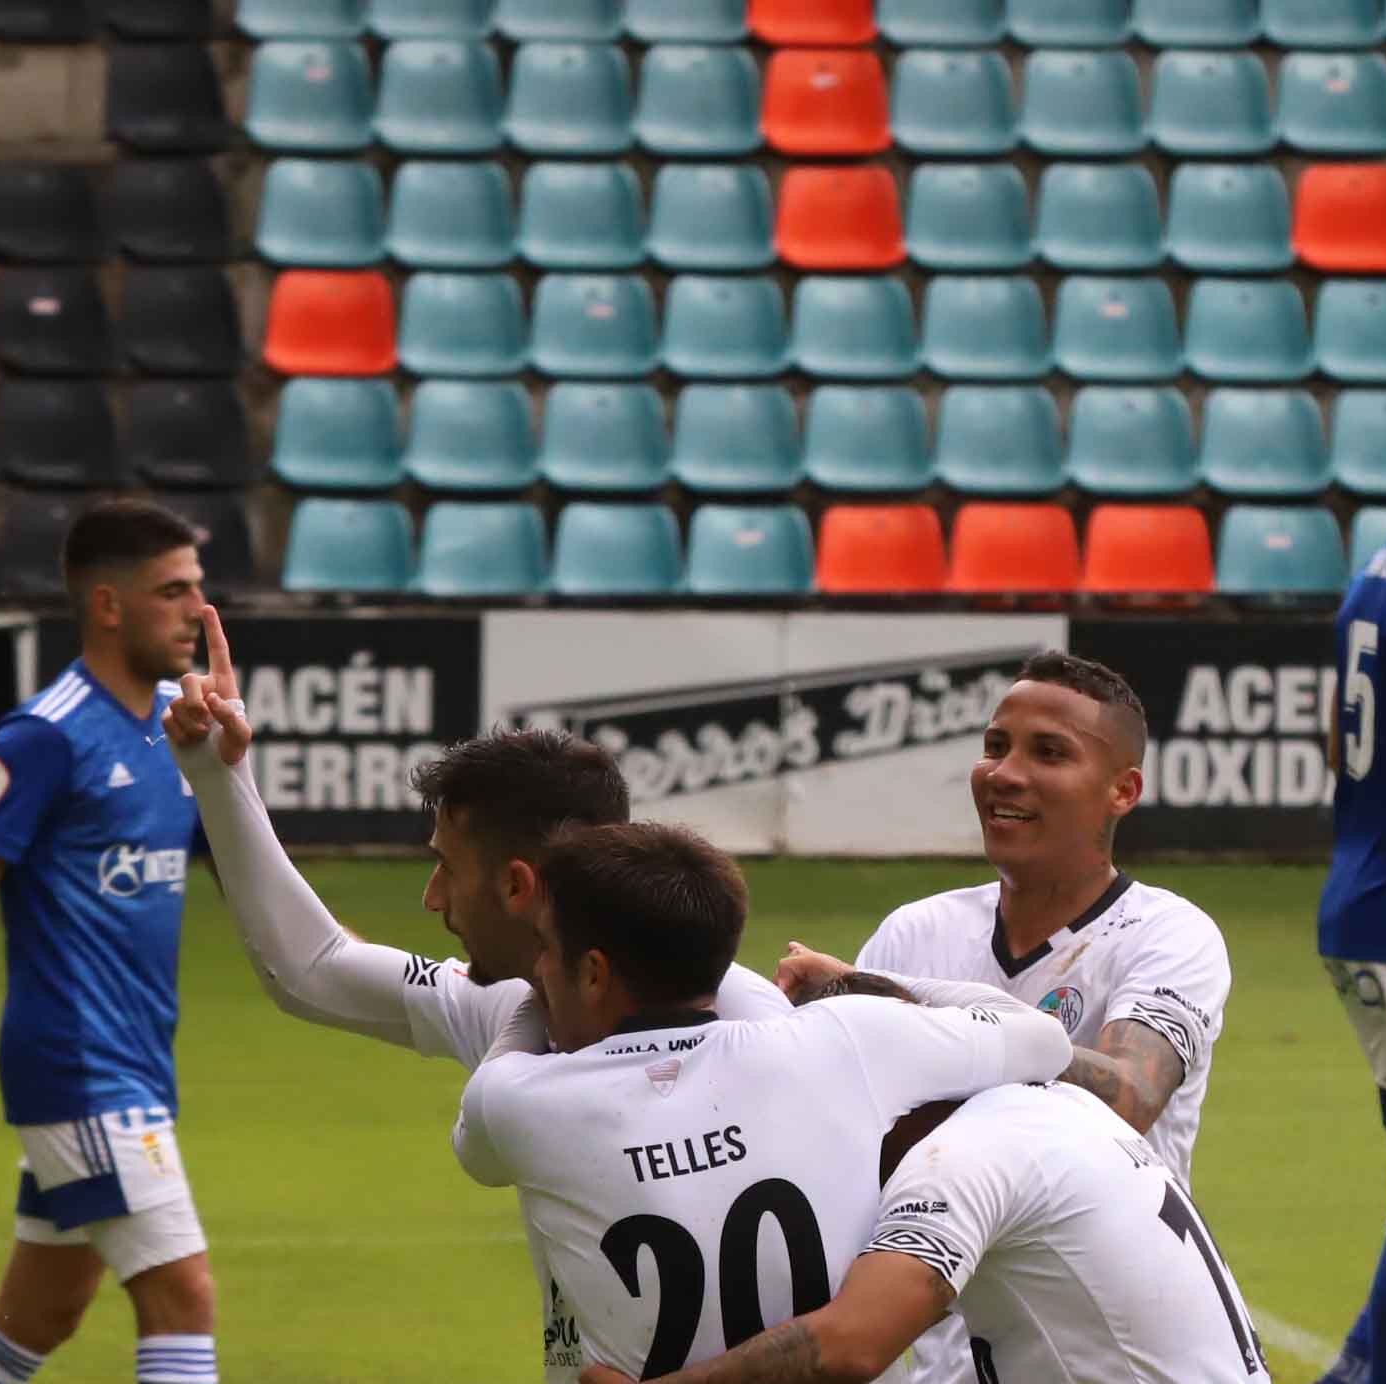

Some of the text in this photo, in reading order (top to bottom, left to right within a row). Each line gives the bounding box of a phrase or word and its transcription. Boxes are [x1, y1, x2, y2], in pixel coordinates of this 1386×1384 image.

[1344, 619, 1380, 781] 5
[623, 1124, 747, 1183] TELLES
[599, 1177, 831, 1382] 20
